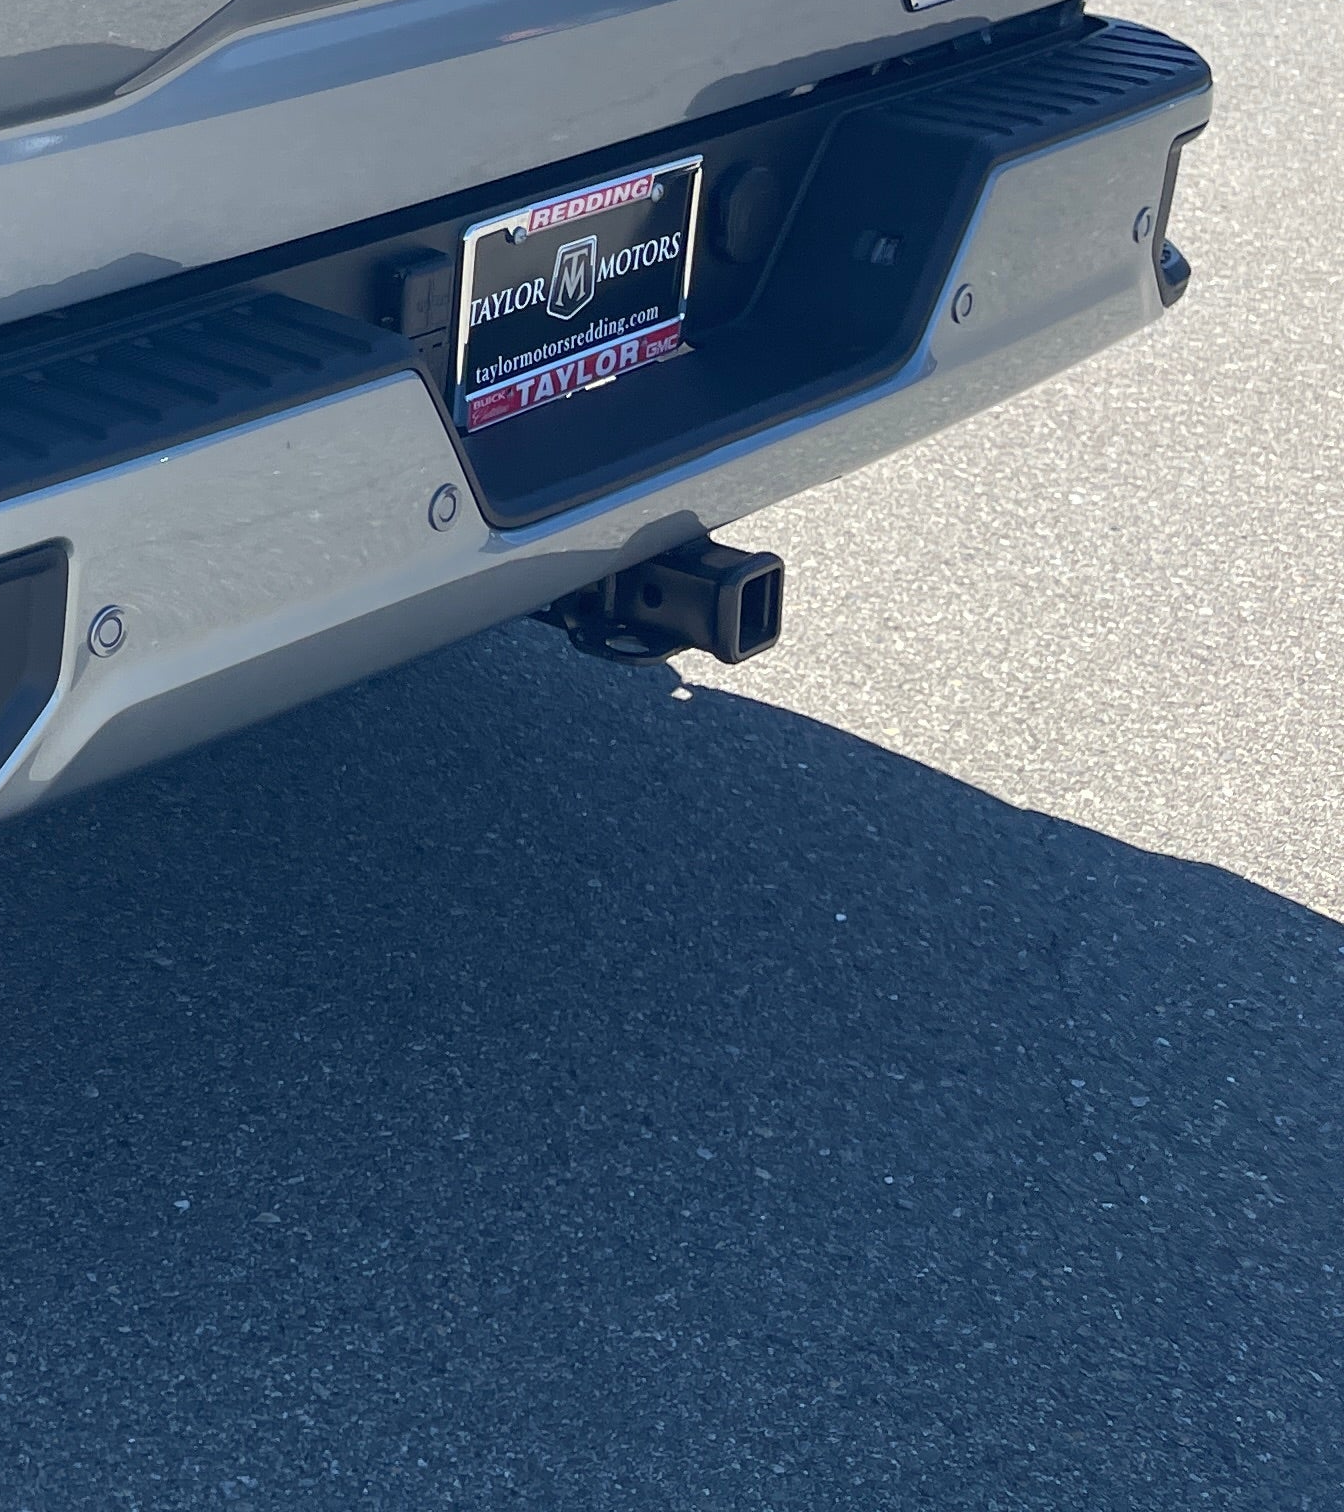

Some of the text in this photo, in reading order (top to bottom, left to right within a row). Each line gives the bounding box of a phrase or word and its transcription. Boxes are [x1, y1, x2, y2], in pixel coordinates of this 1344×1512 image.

[531, 176, 650, 229] REDDING
[470, 276, 547, 327] TAYLOR
[597, 231, 682, 283] MOTORS
[473, 333, 679, 410] BUICK TAYLOR GMC
[475, 305, 660, 385] taylormotorsredding.com
